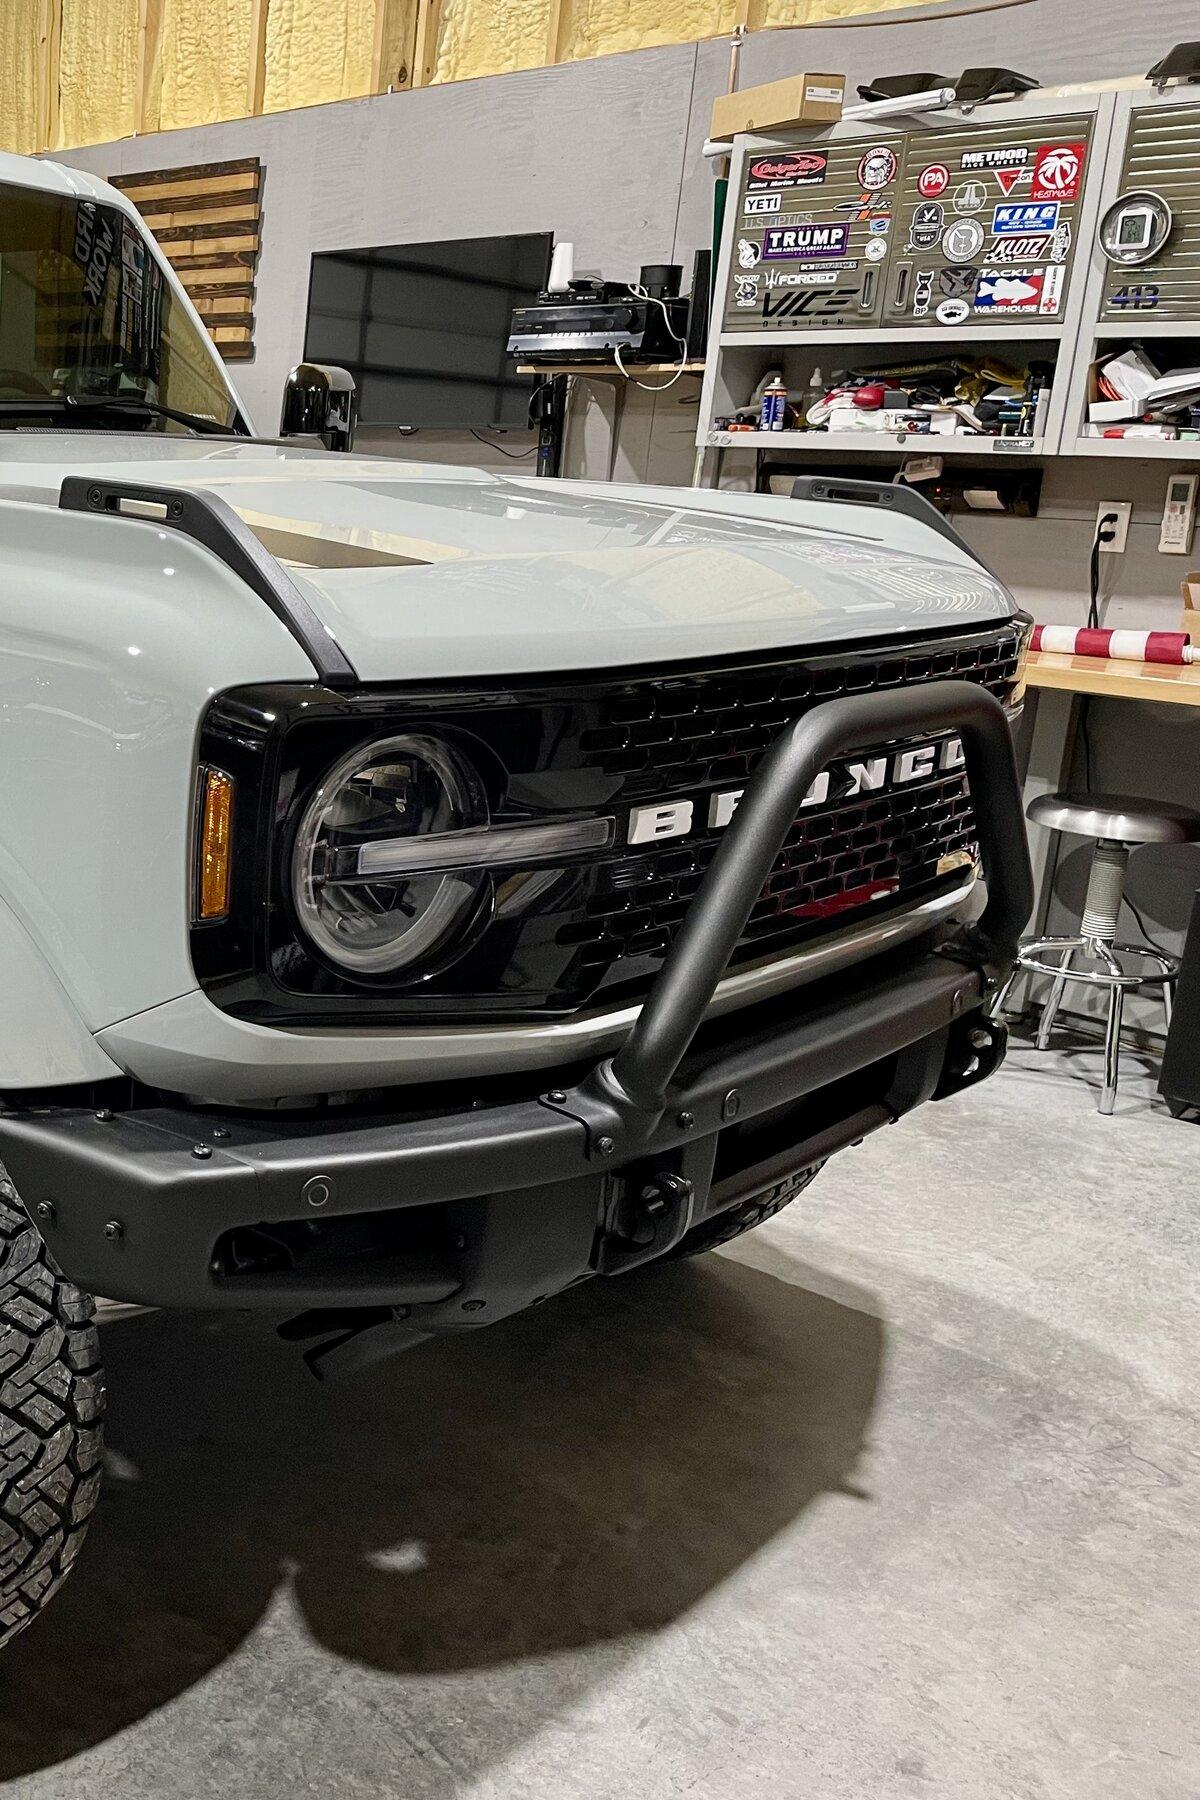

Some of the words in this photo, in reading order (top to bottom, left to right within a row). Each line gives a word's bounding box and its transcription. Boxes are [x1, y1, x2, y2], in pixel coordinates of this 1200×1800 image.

[961, 148, 1028, 163] METHOD
[988, 158, 1027, 166] WHEELS
[924, 171, 944, 186] PA
[1034, 189, 1074, 198] HEATWAVE
[748, 198, 778, 210] YETI
[997, 206, 1056, 221] KING
[770, 228, 844, 247] TRUMP
[994, 238, 1047, 255] KLOTZ
[778, 272, 837, 285] FORGED
[980, 268, 1044, 278] TACKLE
[762, 289, 861, 317] VICE
[1111, 285, 1159, 309] 413
[974, 304, 1038, 314] WAREHOUSE
[763, 318, 845, 327] DESIGN
